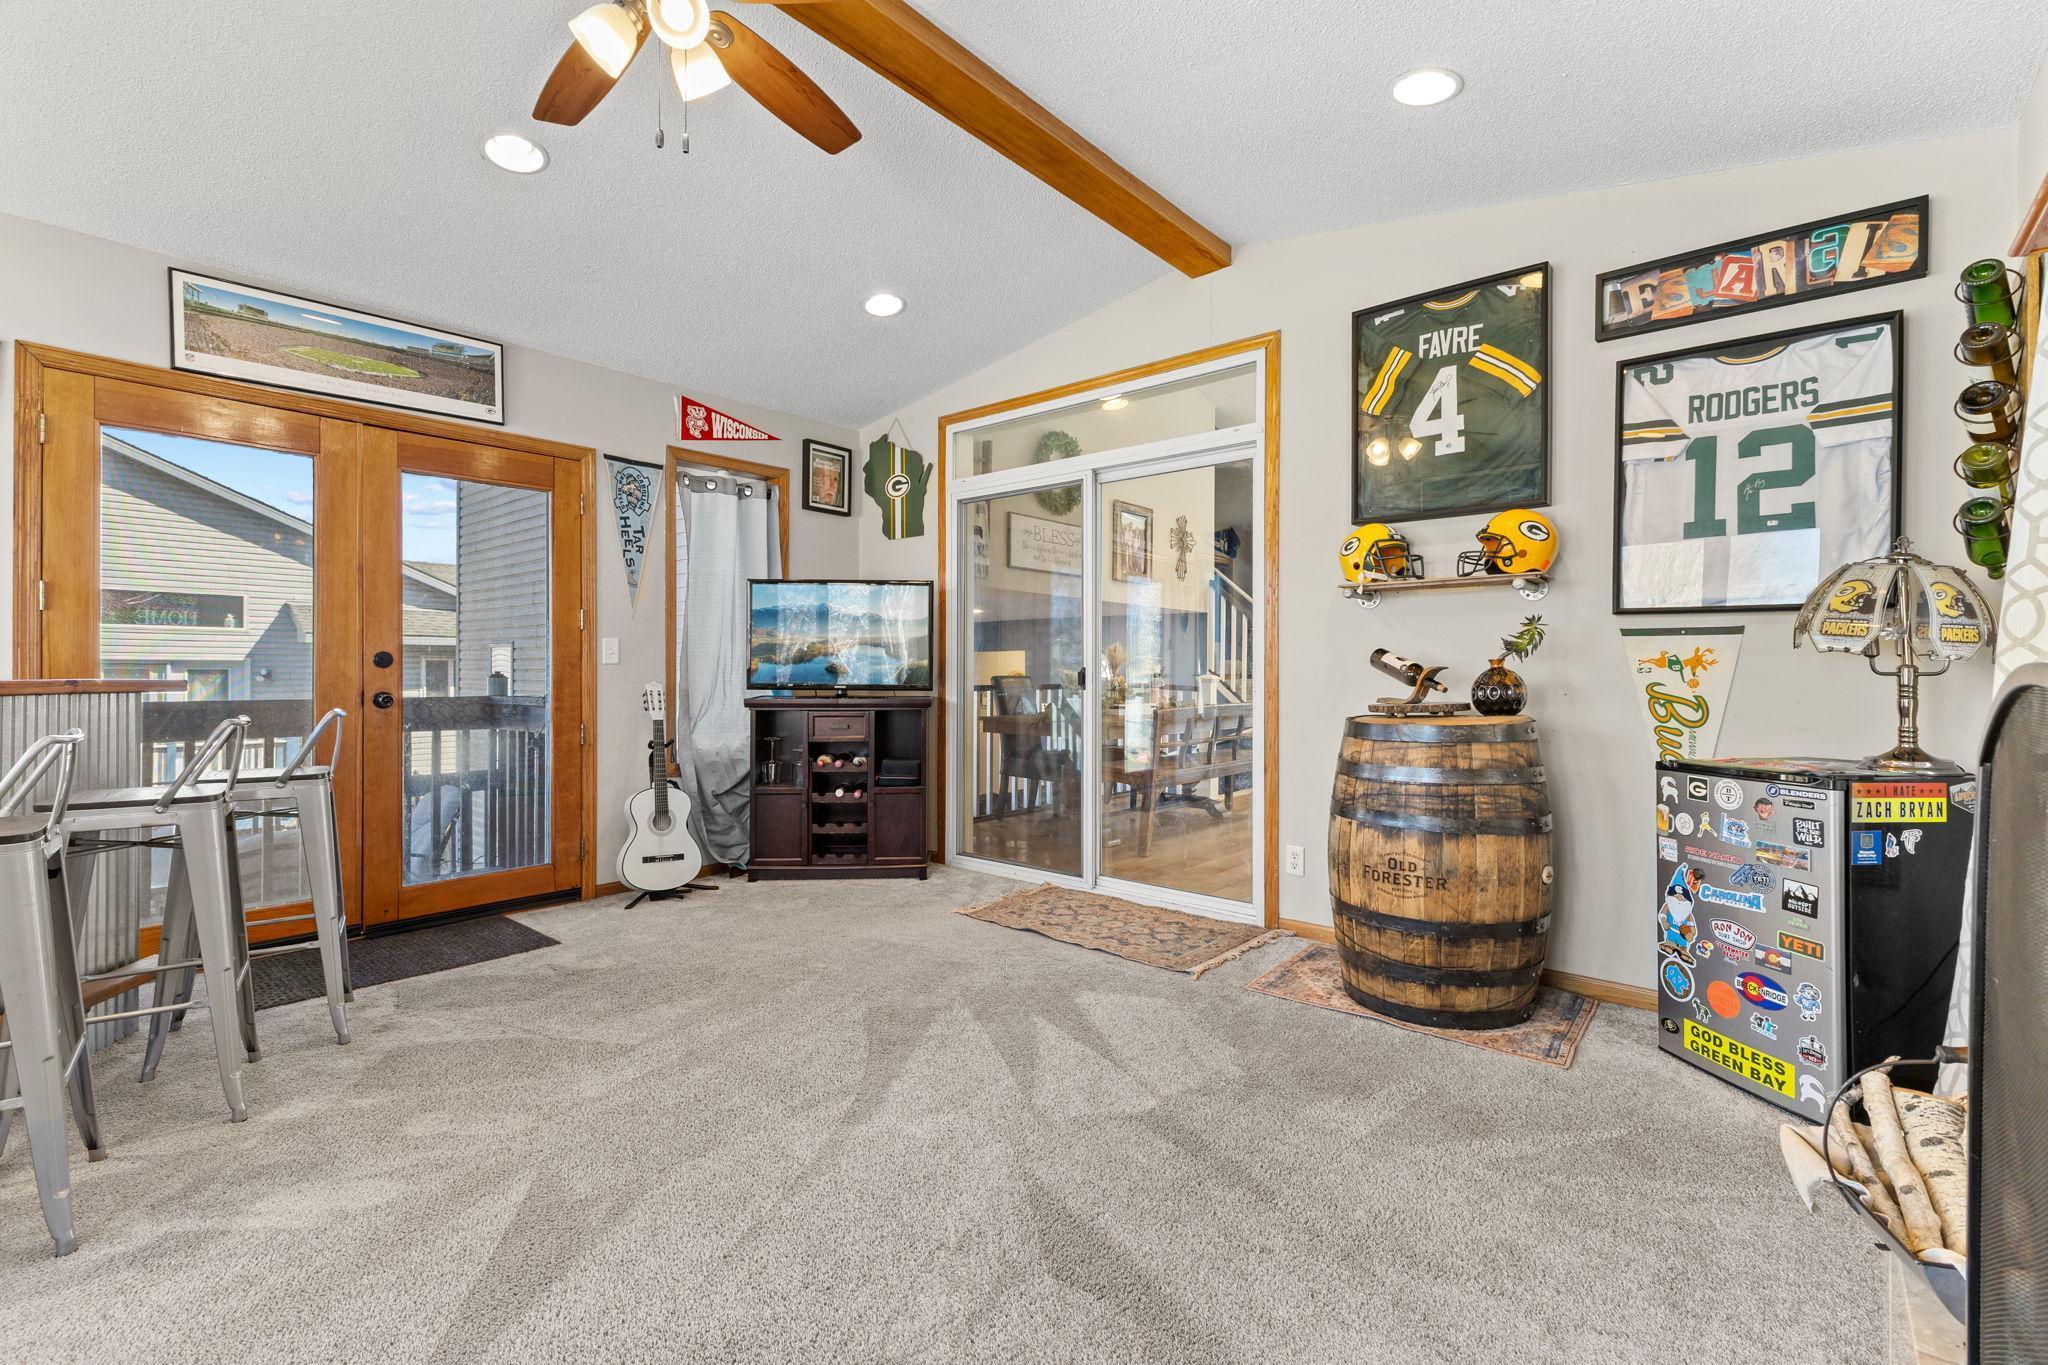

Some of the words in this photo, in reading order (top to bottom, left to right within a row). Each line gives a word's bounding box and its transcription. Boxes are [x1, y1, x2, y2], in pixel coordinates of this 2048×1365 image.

[1418, 323, 1484, 359] FAVRE
[1409, 364, 1466, 457] 4
[1688, 376, 1819, 424] RODGERS
[711, 411, 769, 440] WISCONSIN
[886, 475, 910, 498] G
[1683, 423, 1816, 539] 12
[619, 516, 636, 568] HEELS
[633, 526, 645, 555] TAR
[1821, 621, 1868, 637] PACKERS
[1941, 627, 1980, 643] PACKERS
[1690, 781, 1707, 797] G
[1780, 790, 1826, 800] BLENDERS
[1893, 785, 1916, 796] HATE
[1857, 802, 1892, 818] ZACH
[1900, 802, 1943, 818] BRYAN
[1794, 819, 1822, 830] BUILT
[1388, 857, 1417, 872] OLD
[1362, 864, 1448, 891] FORESTER
[1700, 885, 1762, 910] CAROLINA
[1713, 922, 1732, 932] RON
[1733, 928, 1753, 942] JON
[1718, 931, 1730, 939] SURF
[1732, 937, 1747, 946] SHOP
[1715, 941, 1749, 958] CLEARWATER
[1722, 950, 1740, 961] BEACH
[1780, 935, 1821, 958] YETI
[1736, 979, 1786, 1004] BRECKENRIDGE
[1690, 1025, 1723, 1048] GOD
[1728, 1042, 1786, 1076] BLESS
[1690, 1039, 1743, 1074] GREEN
[1750, 1068, 1786, 1092] BAY
